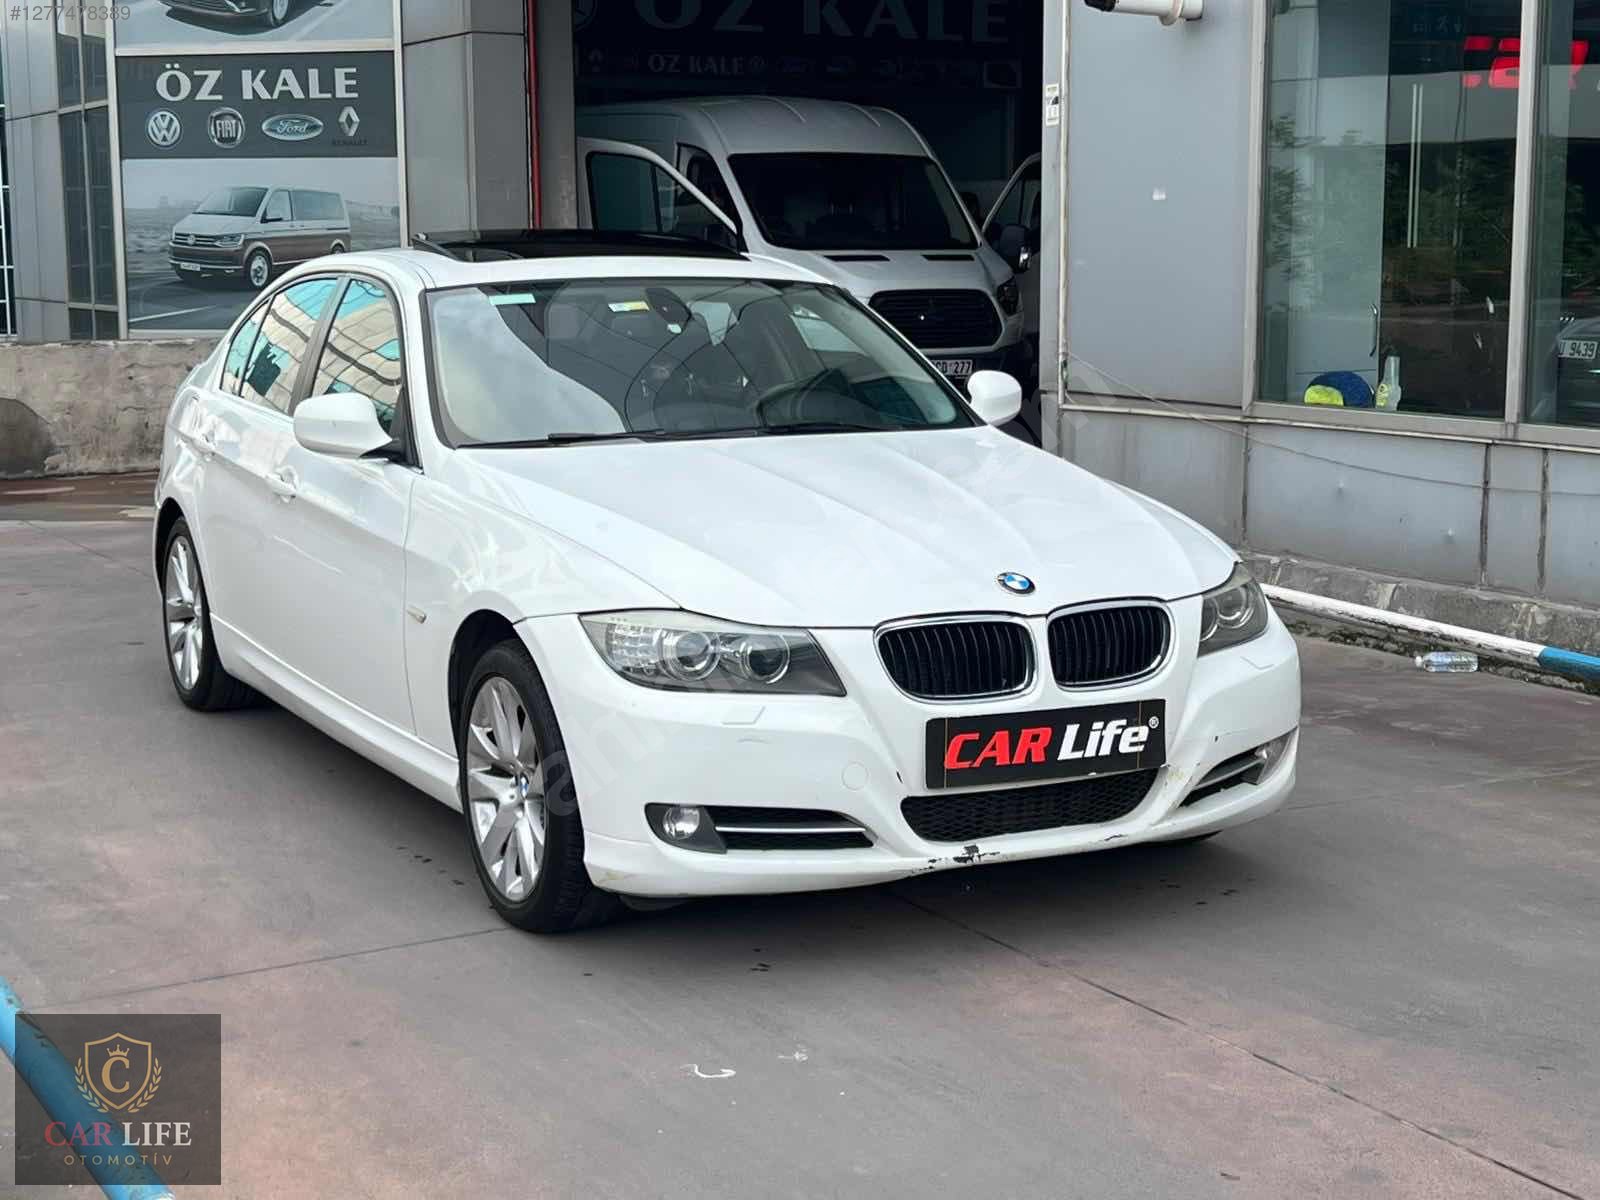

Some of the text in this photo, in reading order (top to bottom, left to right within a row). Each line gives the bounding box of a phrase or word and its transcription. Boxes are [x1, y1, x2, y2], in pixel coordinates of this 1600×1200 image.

[155, 63, 359, 101] ÖZ KALE
[215, 119, 238, 138] FIAT
[275, 119, 308, 134] Ford
[1569, 342, 1596, 357] 9439
[954, 361, 971, 374] 277
[943, 726, 1053, 770] CAR
